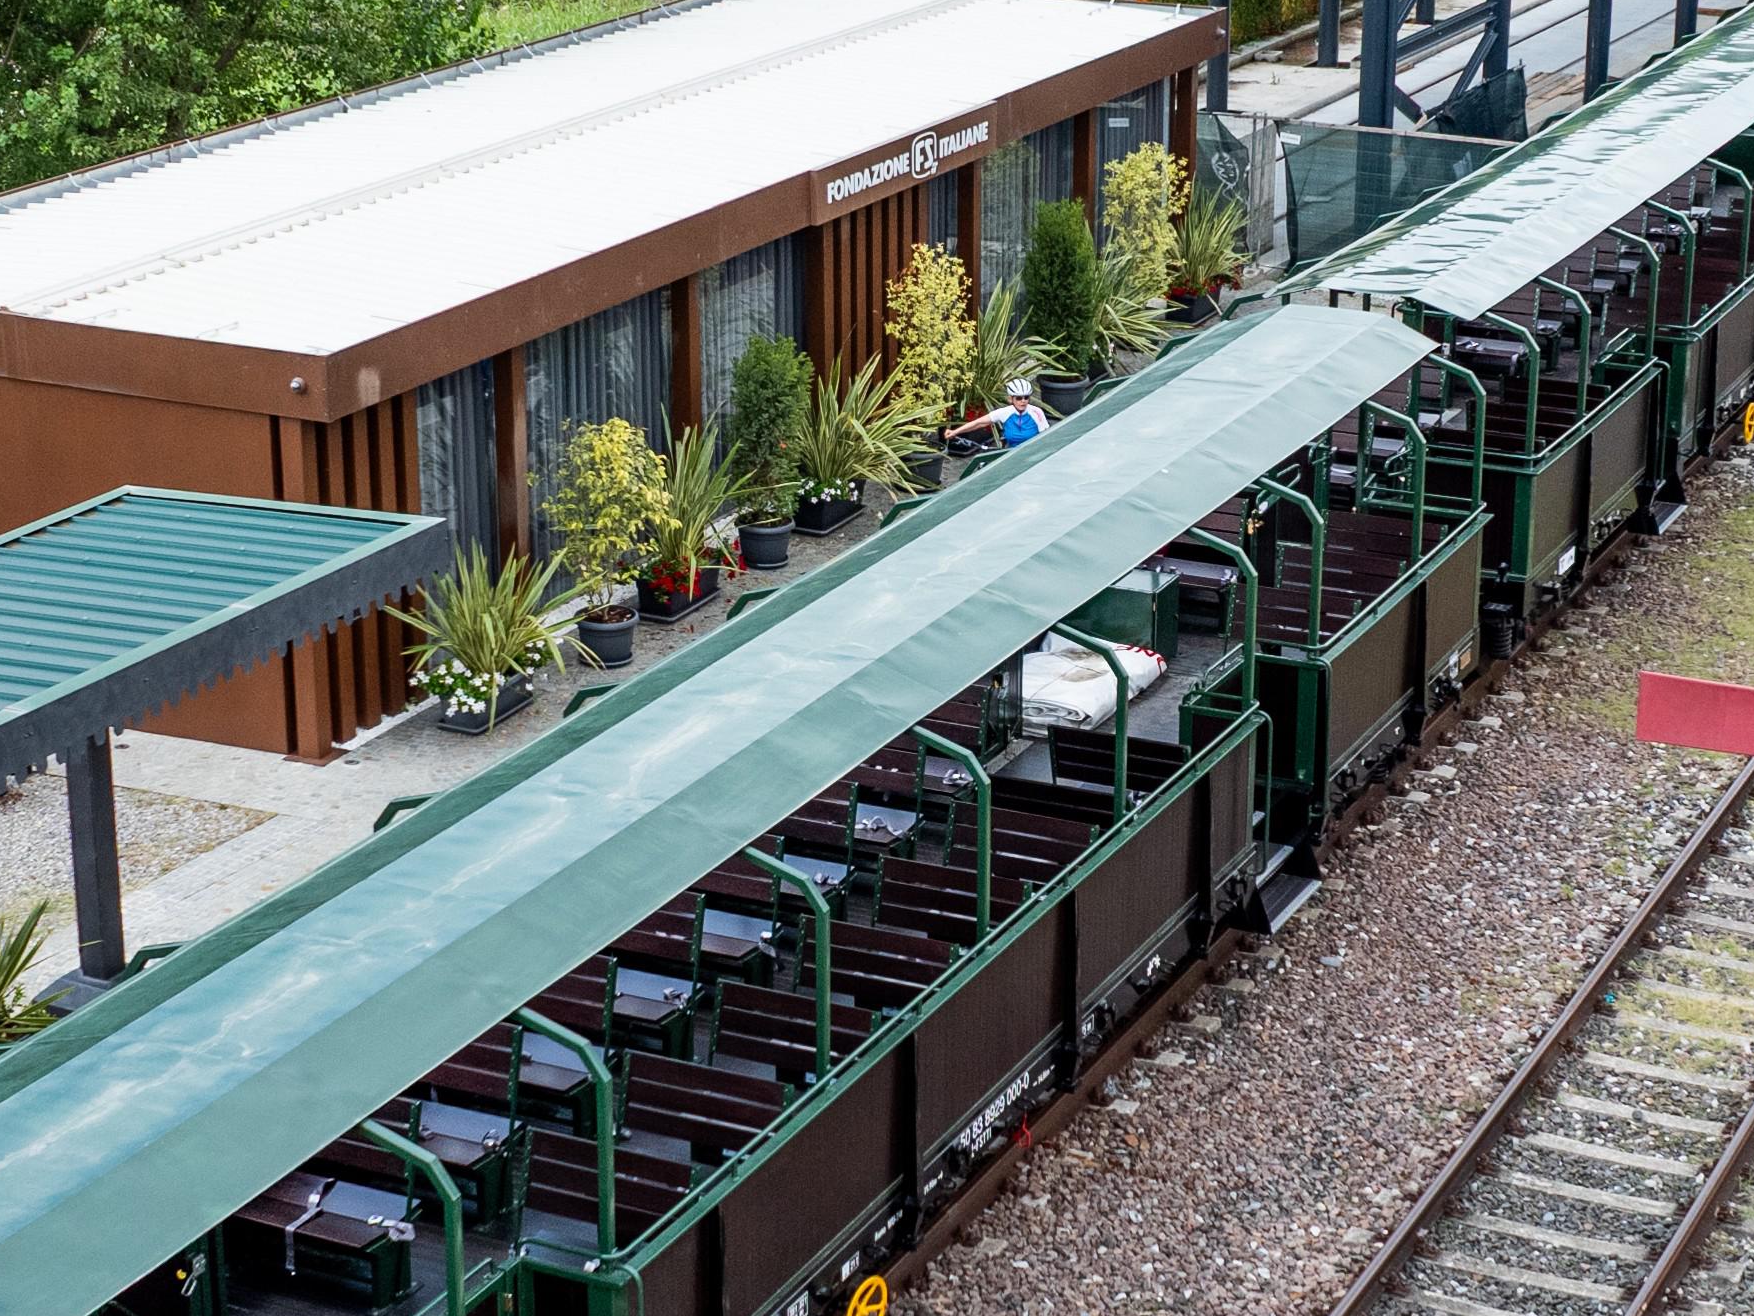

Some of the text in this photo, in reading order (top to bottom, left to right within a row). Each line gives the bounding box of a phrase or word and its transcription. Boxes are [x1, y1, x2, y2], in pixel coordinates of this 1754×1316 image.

[827, 121, 989, 204] FONDAZIONE FS ITALIANE
[960, 1129, 971, 1148] 50
[972, 1116, 983, 1139] 83
[1006, 1071, 1030, 1105] 000-0
